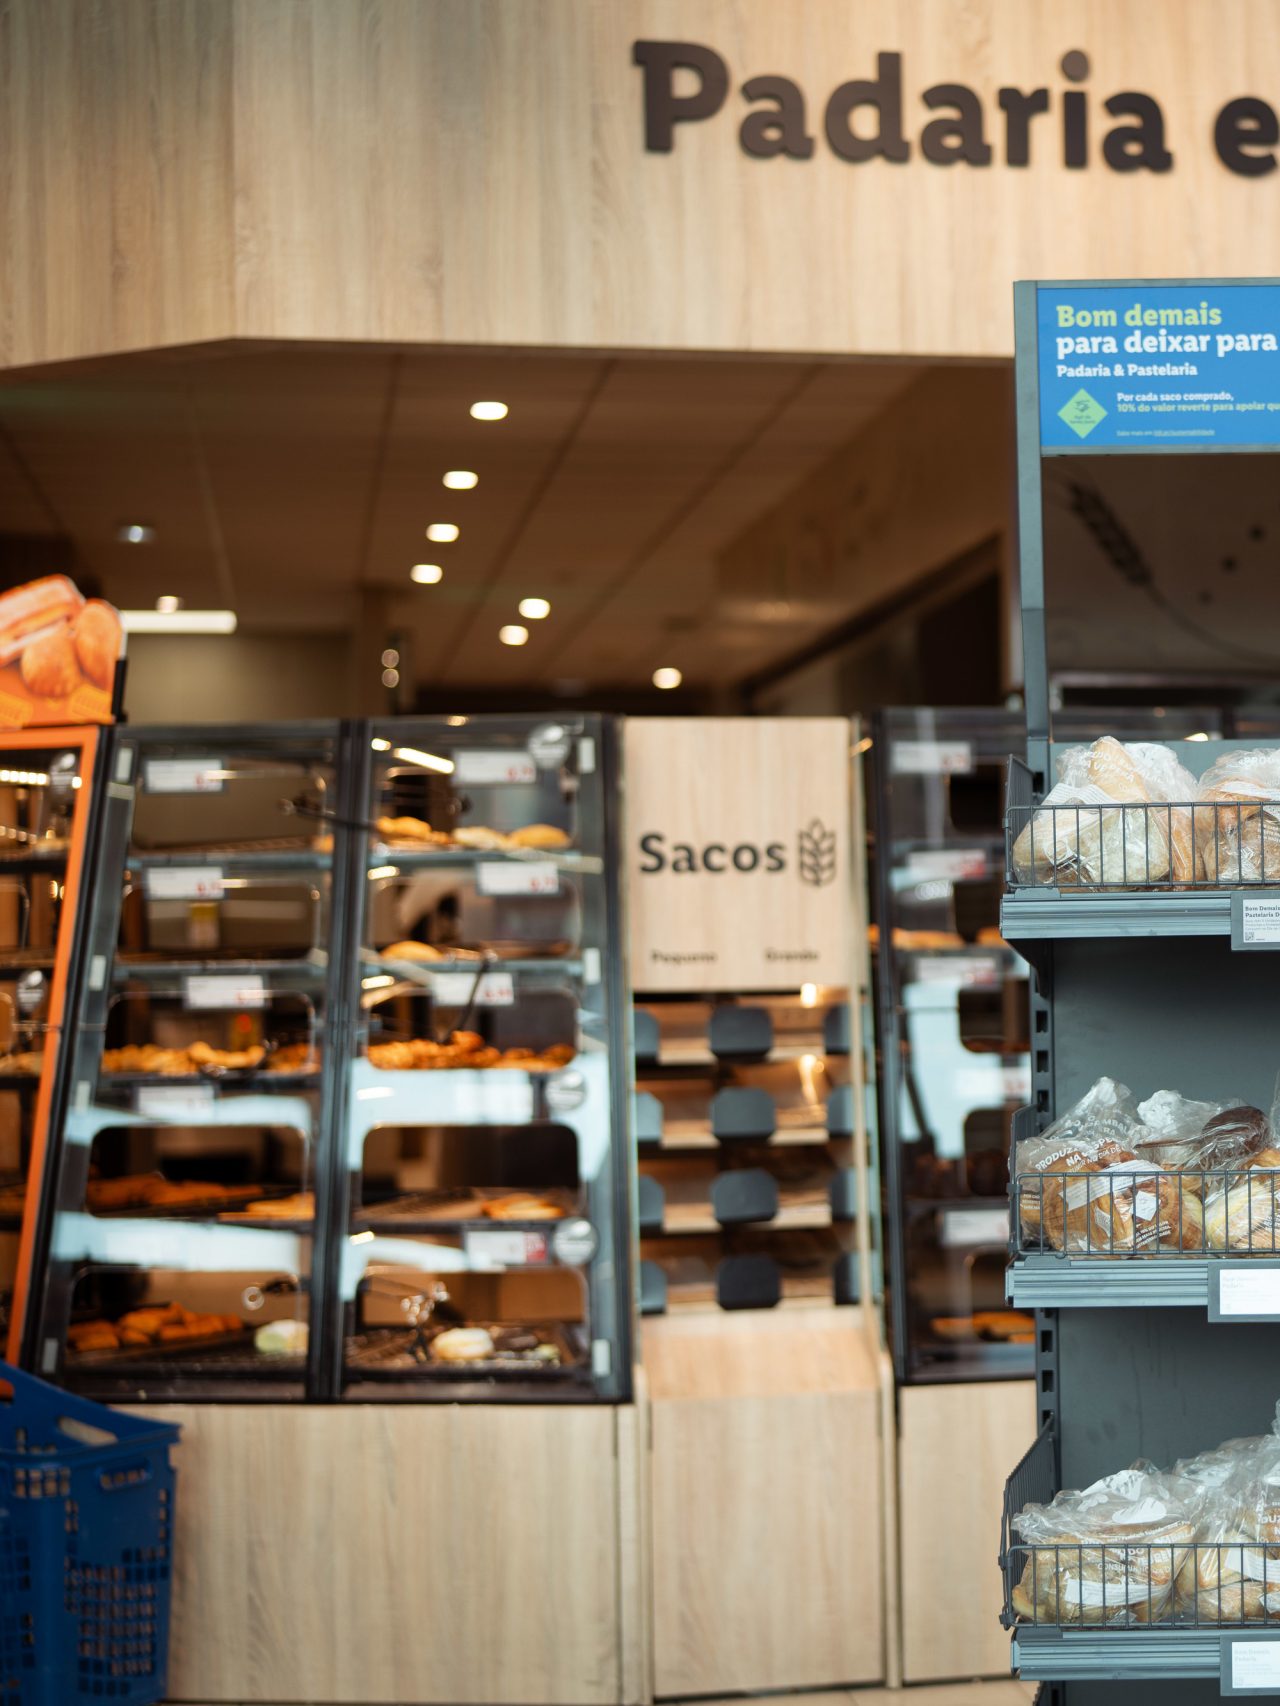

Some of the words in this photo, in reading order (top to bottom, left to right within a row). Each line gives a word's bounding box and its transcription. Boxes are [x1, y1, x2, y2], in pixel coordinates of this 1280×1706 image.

[632, 40, 1173, 173] Padaria
[1213, 97, 1280, 177] e
[1056, 305, 1118, 327] Bom
[1124, 302, 1222, 326] demais
[1056, 336, 1118, 359] para
[1124, 328, 1211, 353] deixar
[1216, 333, 1278, 357] para
[1056, 365, 1112, 377] Padaria
[1113, 364, 1125, 377] &
[1127, 363, 1198, 377] Pastelaria
[1117, 392, 1134, 402] Por
[1135, 392, 1158, 402] cada
[1160, 393, 1182, 401] saco
[1183, 390, 1234, 402] comprado,
[1117, 404, 1137, 412] 10%
[1138, 403, 1150, 412] do
[1152, 403, 1176, 411] valor
[1177, 403, 1210, 411] reverte
[1212, 403, 1234, 412] para
[1235, 401, 1265, 411] apoiar
[639, 832, 787, 874] Sacos
